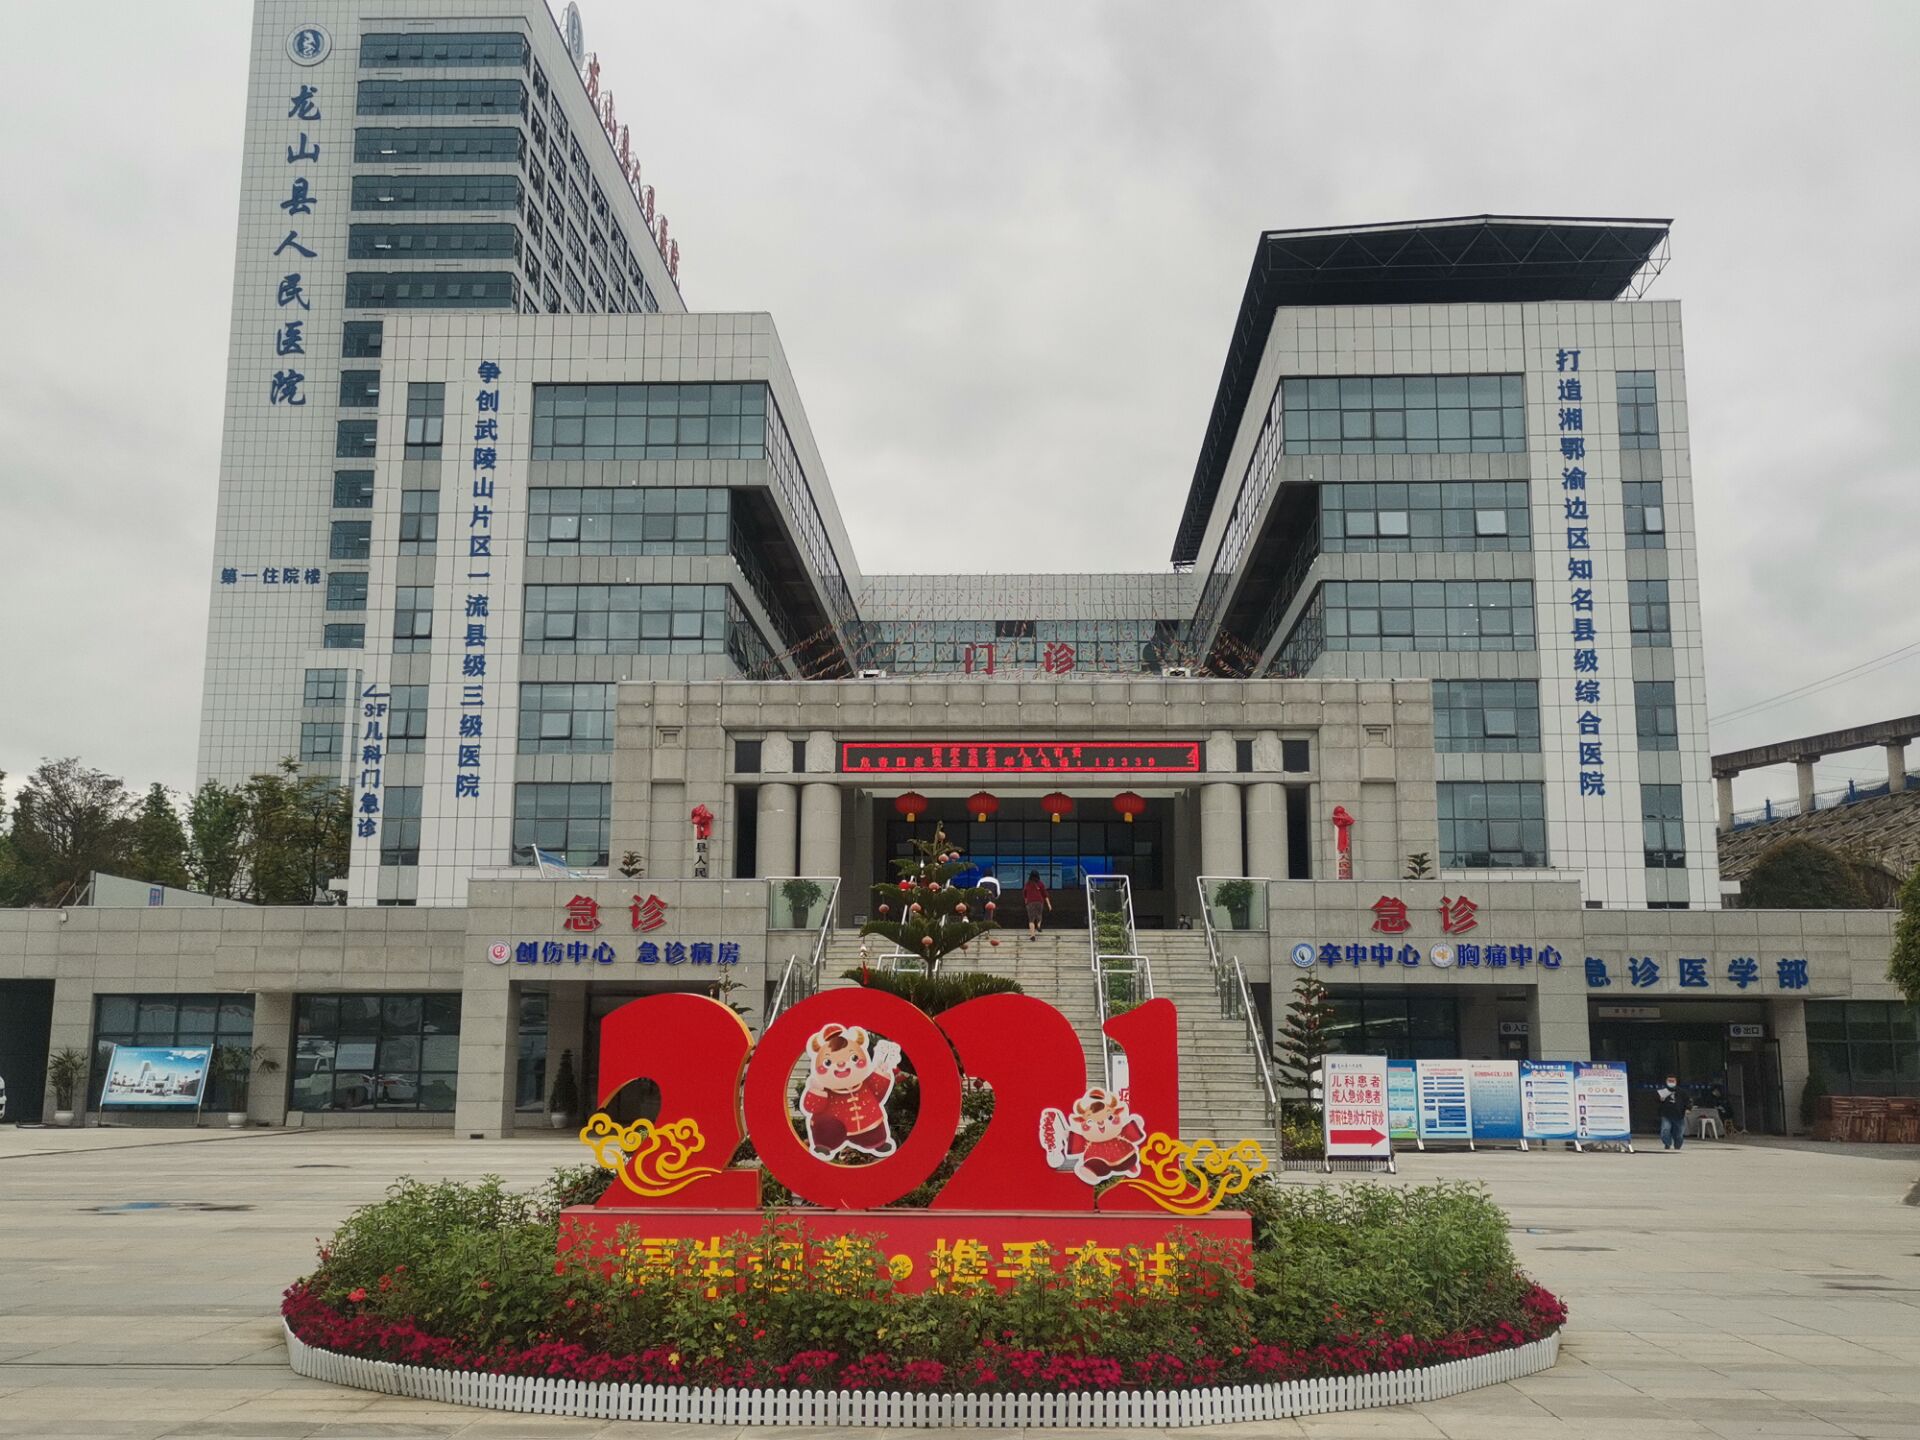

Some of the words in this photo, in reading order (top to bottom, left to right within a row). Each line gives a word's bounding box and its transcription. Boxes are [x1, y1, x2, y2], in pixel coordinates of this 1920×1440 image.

[269, 85, 321, 407] 龙山县人民医院
[220, 567, 321, 585] 第一住院楼
[455, 360, 501, 799] 争创武陵山片区一流县级三级医院
[1556, 348, 1606, 797] 打造湘鄂渝边区知名县级综合医院
[964, 642, 1075, 675] 门诊
[563, 894, 669, 932] 急诊
[1370, 895, 1479, 934] 急诊
[515, 941, 616, 965] 创伤中心
[637, 941, 741, 966] 急诊病房
[1318, 943, 1421, 967] 卒中中心
[1457, 943, 1562, 969] 胸痛中心
[1585, 956, 1809, 989] 急诊医学部
[1331, 1075, 1380, 1088] 儿科患者
[1332, 1089, 1381, 1104] 成人急诊患者
[597, 987, 1180, 1211] 2021
